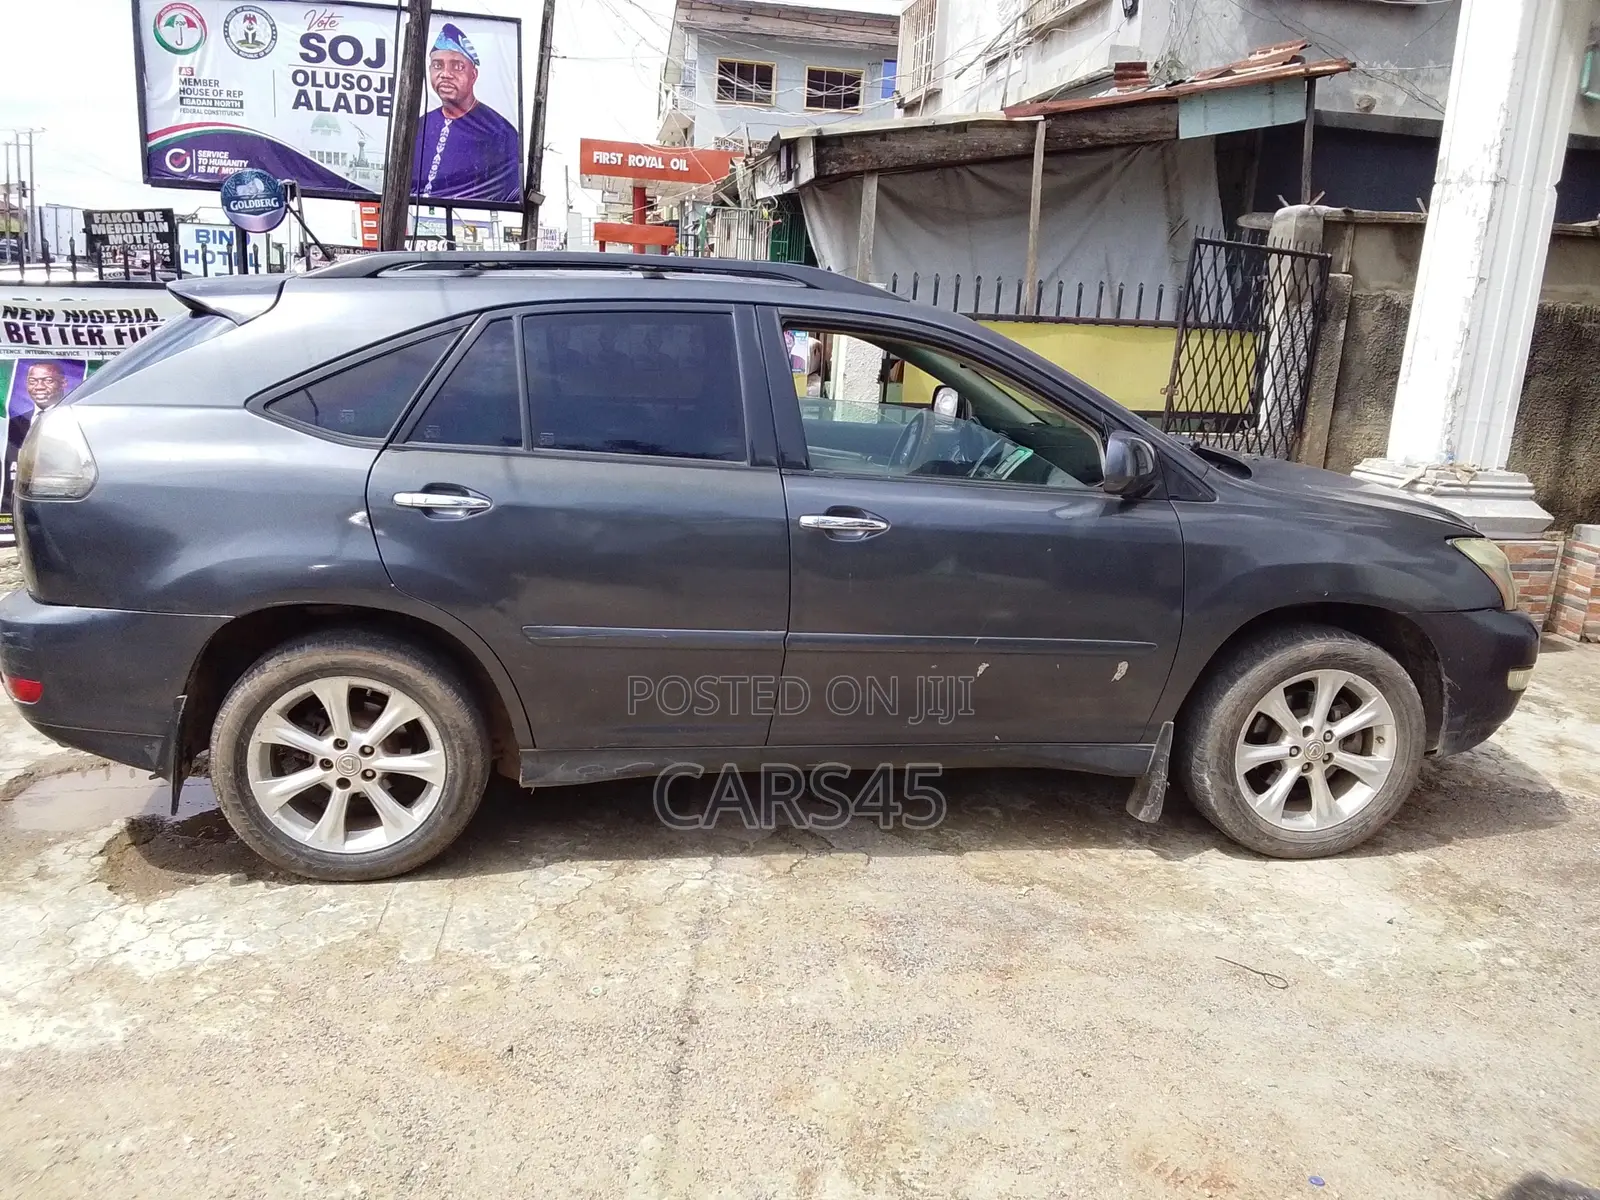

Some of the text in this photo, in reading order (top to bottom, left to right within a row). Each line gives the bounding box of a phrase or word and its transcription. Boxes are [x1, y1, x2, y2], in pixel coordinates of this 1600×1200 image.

[304, 8, 344, 31] Vote
[299, 32, 386, 69] SOJ
[179, 78, 220, 88] MEMBER
[179, 87, 244, 98] HOUSE OF REP
[183, 98, 240, 108] IBADAN NORTH
[292, 89, 392, 117] ALADE
[197, 150, 229, 159] SERVICE
[198, 158, 249, 168] TO HUMANITY
[593, 151, 689, 171] FIRST ROYAL OIL
[230, 198, 279, 210] GOLDBERG
[93, 211, 164, 223] FAKOL DE
[91, 222, 169, 235] MERIDIAN
[108, 233, 160, 245] MOTEL
[2, 305, 55, 322] NEW
[4, 321, 107, 346] BETTER
